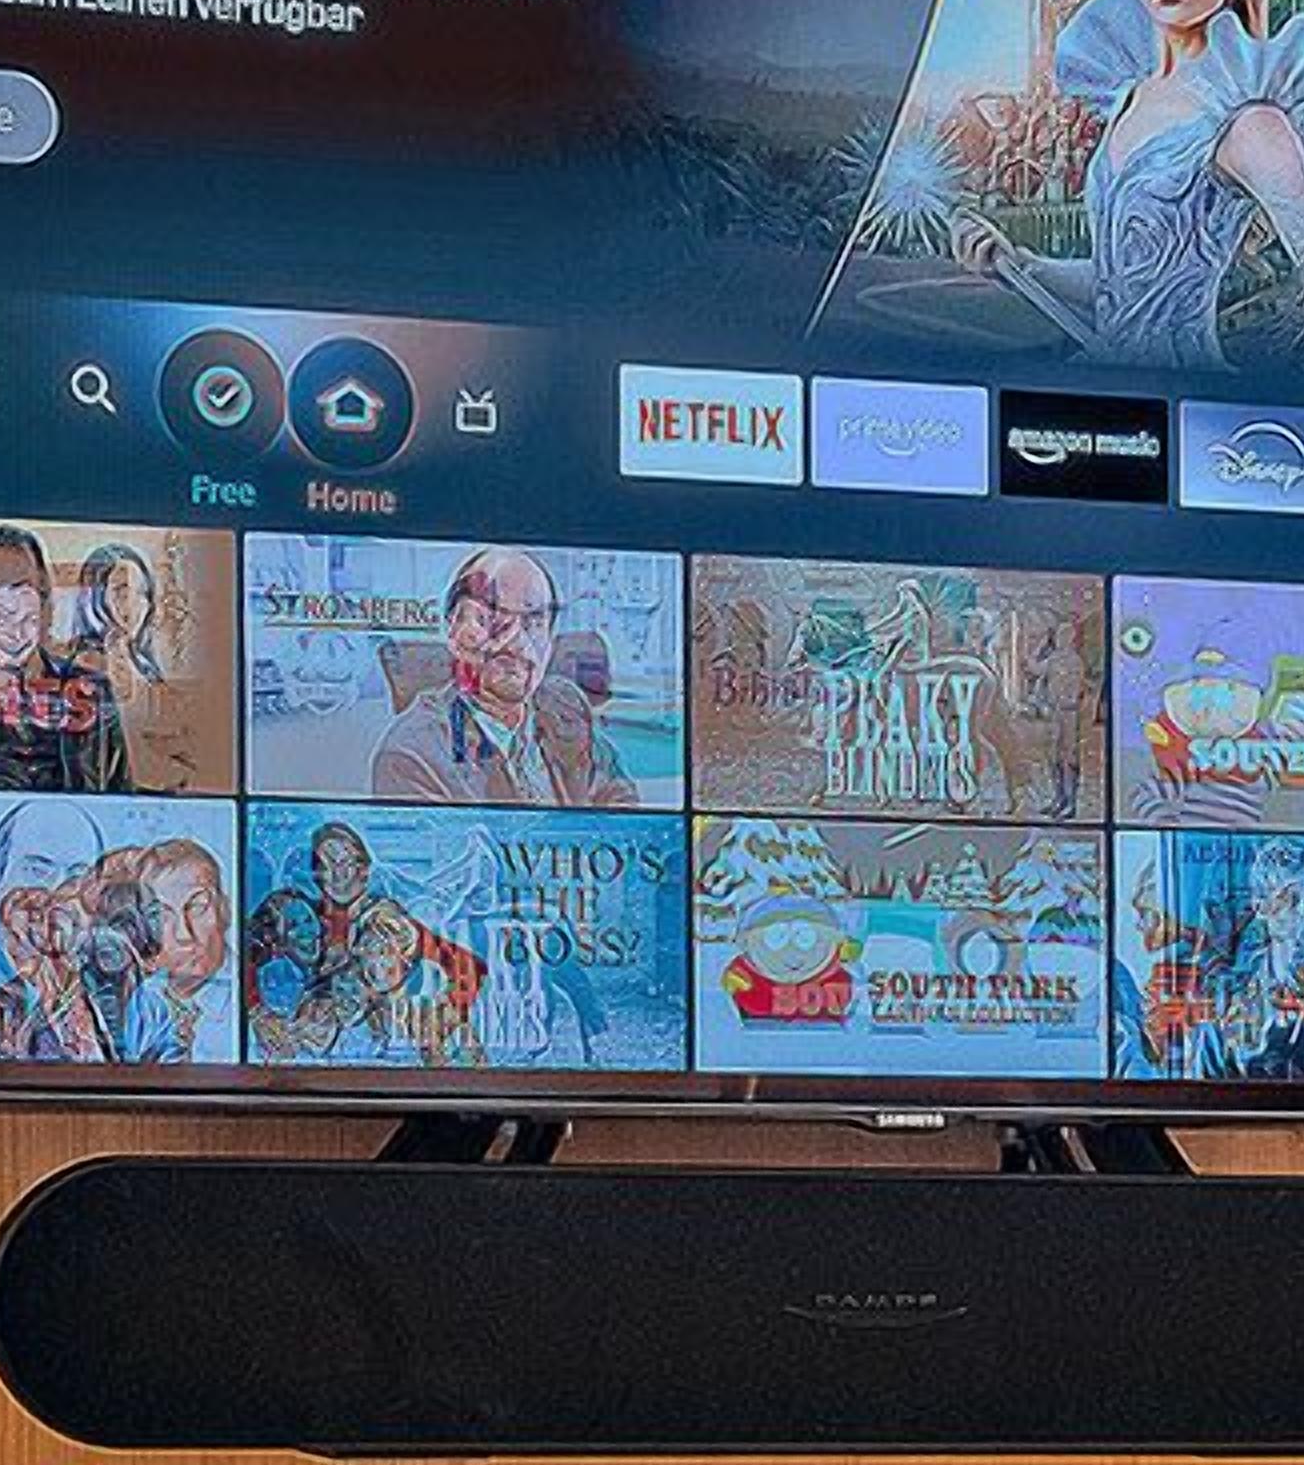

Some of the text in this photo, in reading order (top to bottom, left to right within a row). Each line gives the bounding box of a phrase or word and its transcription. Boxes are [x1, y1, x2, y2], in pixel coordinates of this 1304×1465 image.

[637, 398, 786, 452] NETFLIX
[190, 473, 257, 508] Free
[305, 479, 397, 515] Home
[499, 838, 668, 886] WHO'S
[504, 882, 602, 923] THE
[868, 969, 1080, 1003] SOUTH PARK
